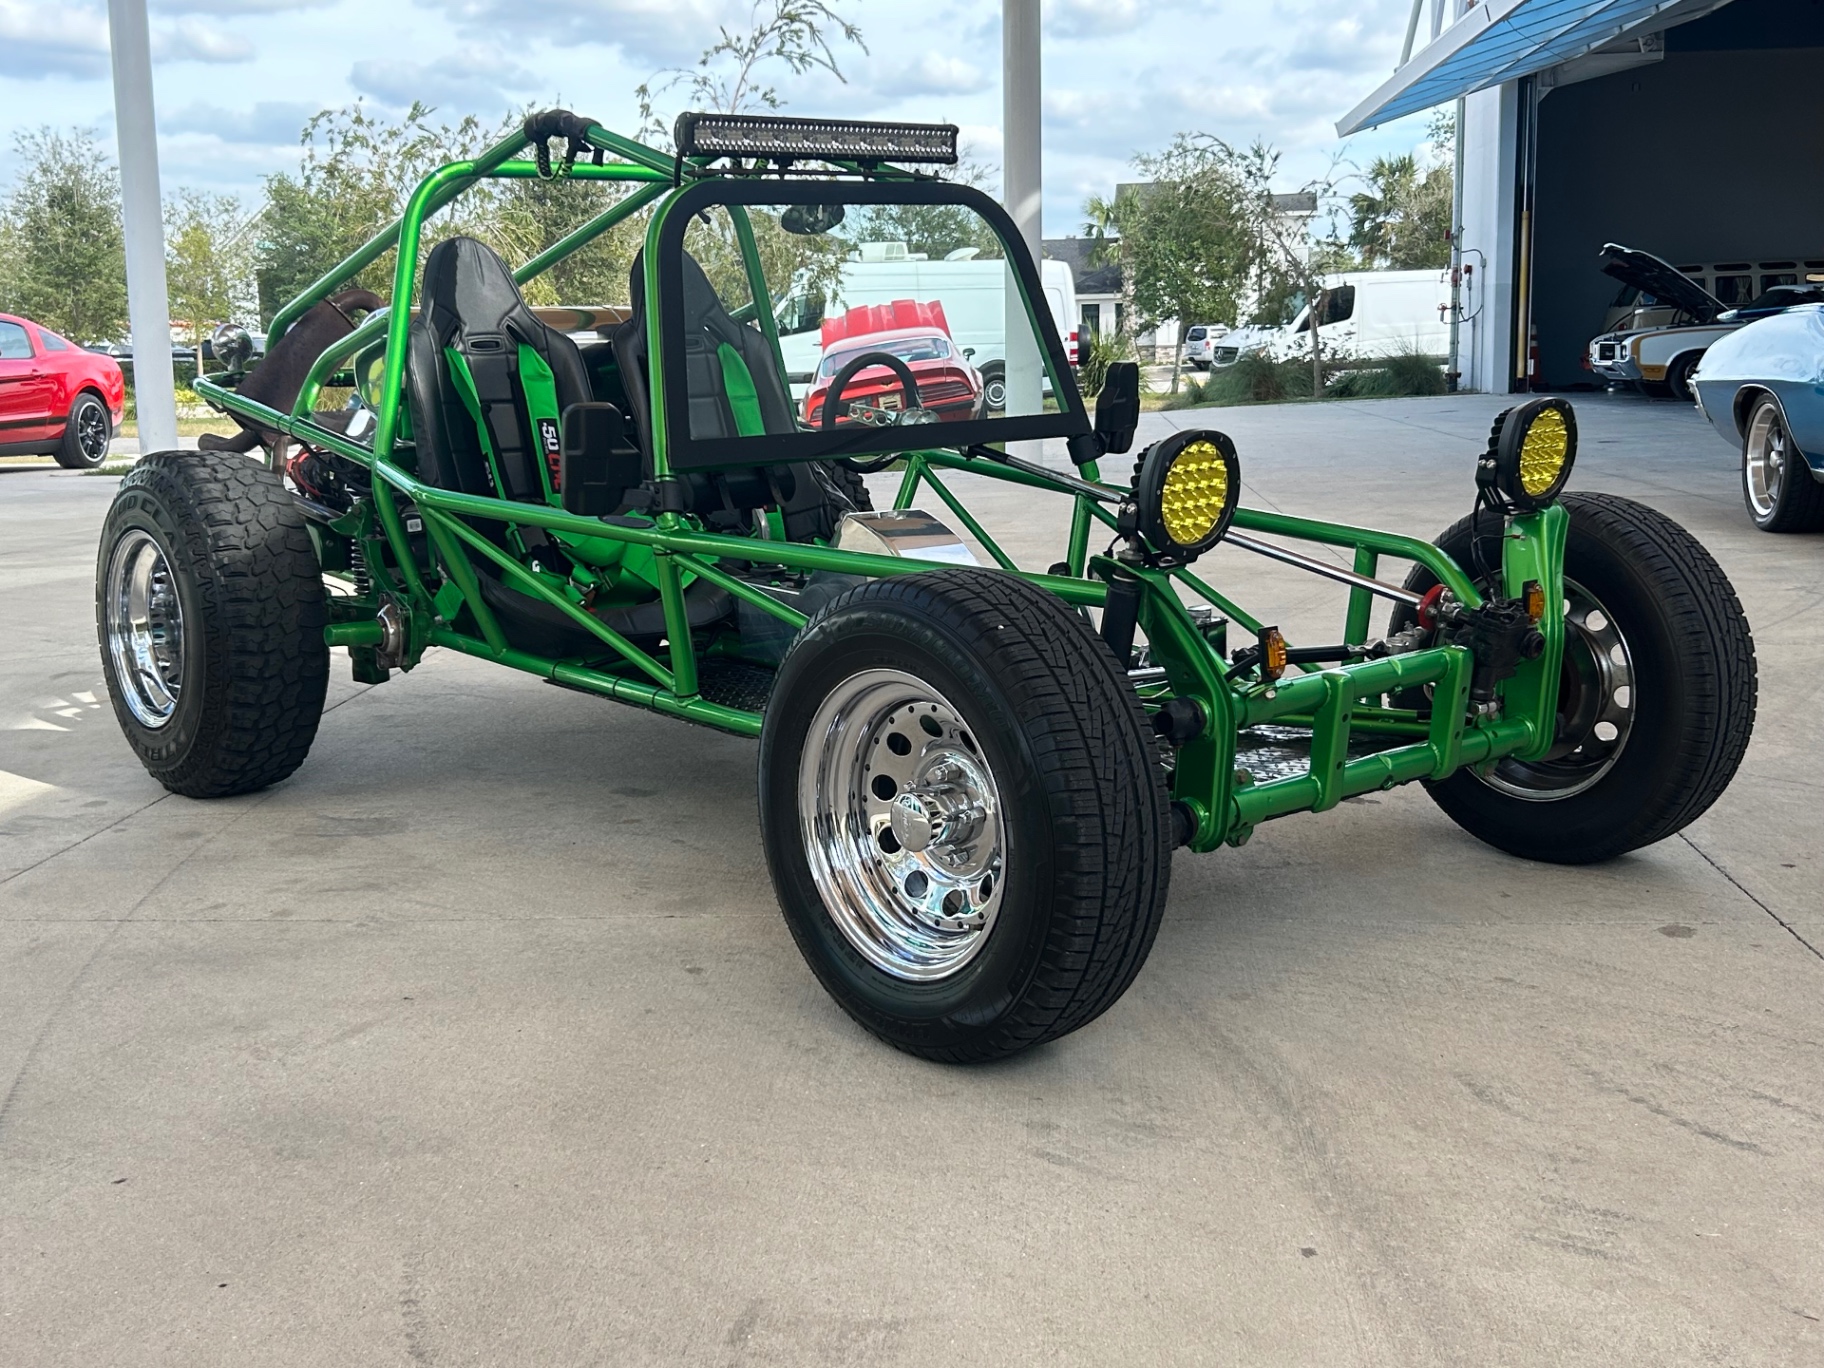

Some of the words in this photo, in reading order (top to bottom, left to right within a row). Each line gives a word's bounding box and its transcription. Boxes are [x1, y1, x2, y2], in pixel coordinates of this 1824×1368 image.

[107, 495, 138, 535] MUD
[139, 496, 189, 573] CLAW
[863, 611, 1011, 732] SUMITOMO
